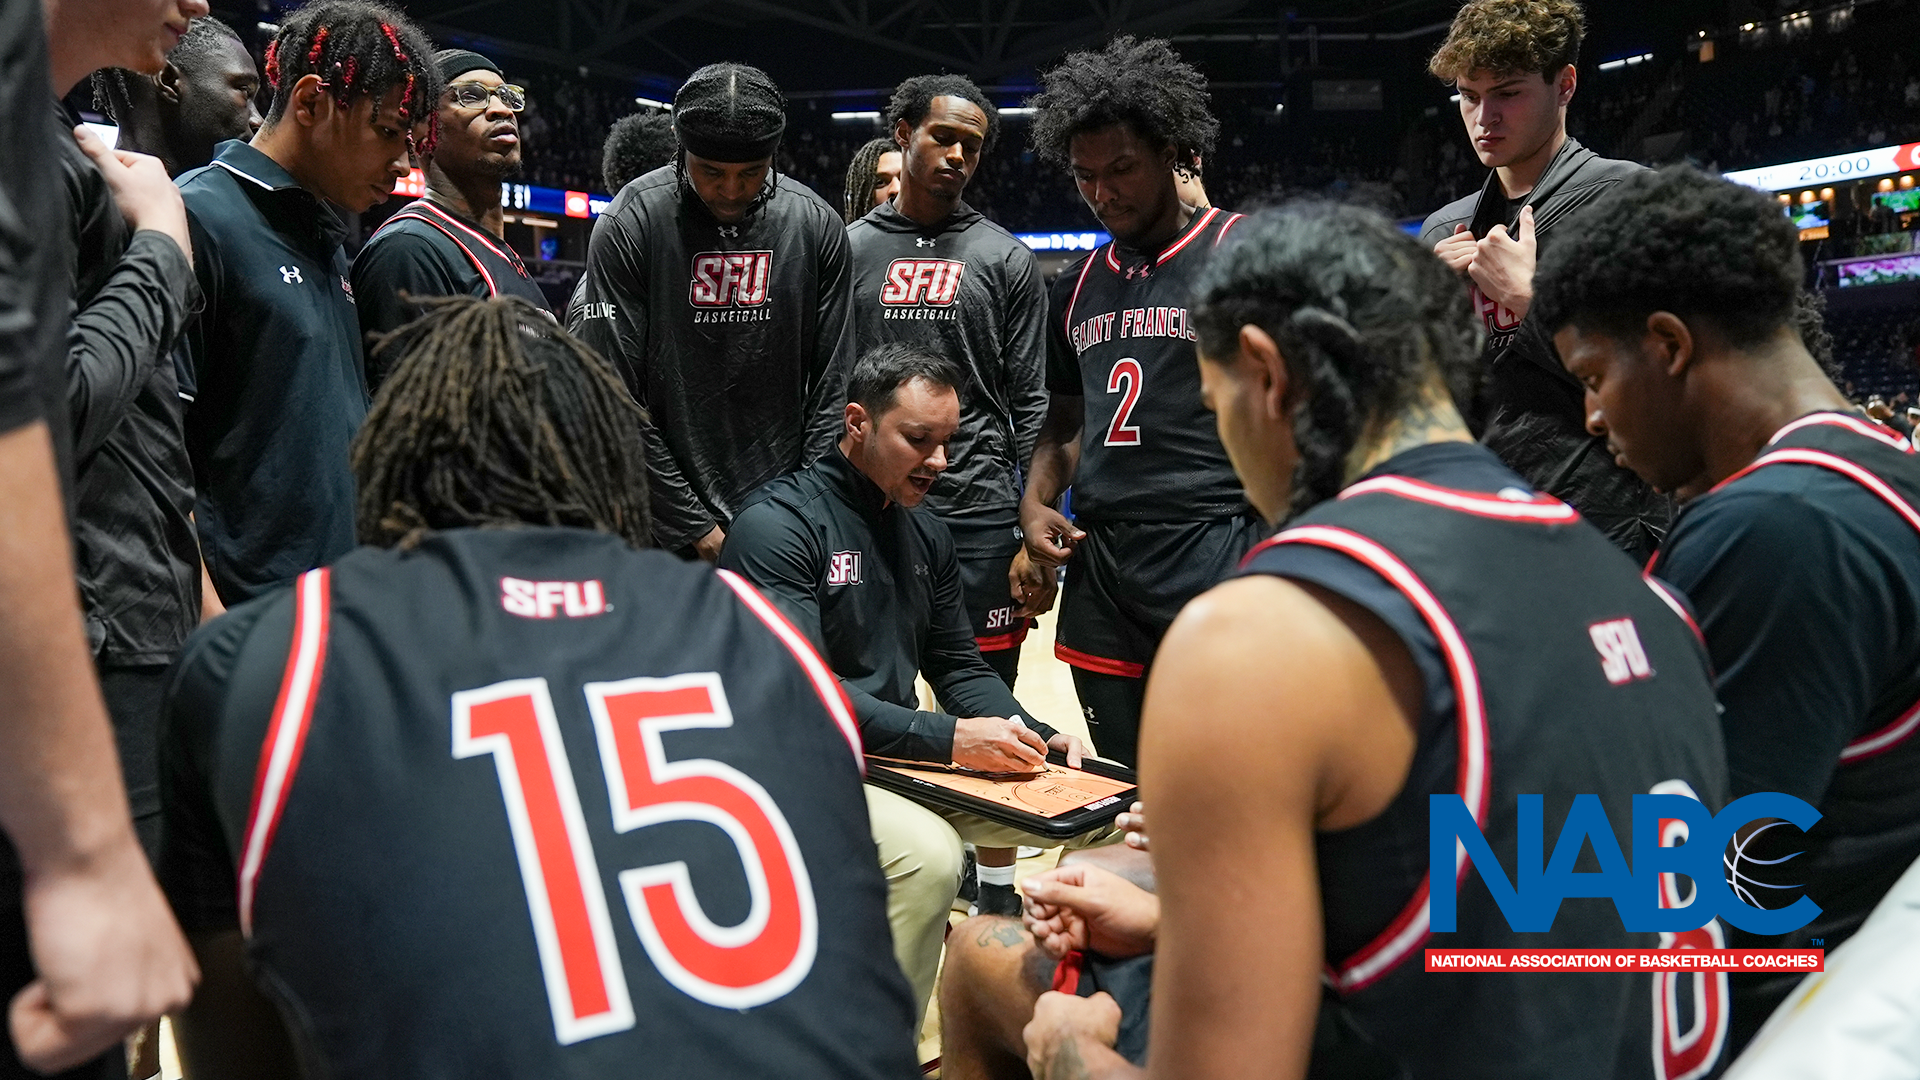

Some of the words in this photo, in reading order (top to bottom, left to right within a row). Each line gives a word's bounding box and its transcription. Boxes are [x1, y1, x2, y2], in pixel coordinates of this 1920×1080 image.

[1800, 157, 1870, 181] 20:00
[691, 252, 771, 306] SFU
[881, 259, 965, 306] SFU
[694, 308, 771, 323] BASKETBALL
[883, 308, 957, 321] BASKETBALL
[1072, 312, 1116, 356] SAINT
[1103, 357, 1144, 447] 2
[827, 550, 863, 586] SFU
[501, 577, 606, 619] SFU
[1588, 618, 1651, 685] SFU
[451, 671, 819, 1046] 15
